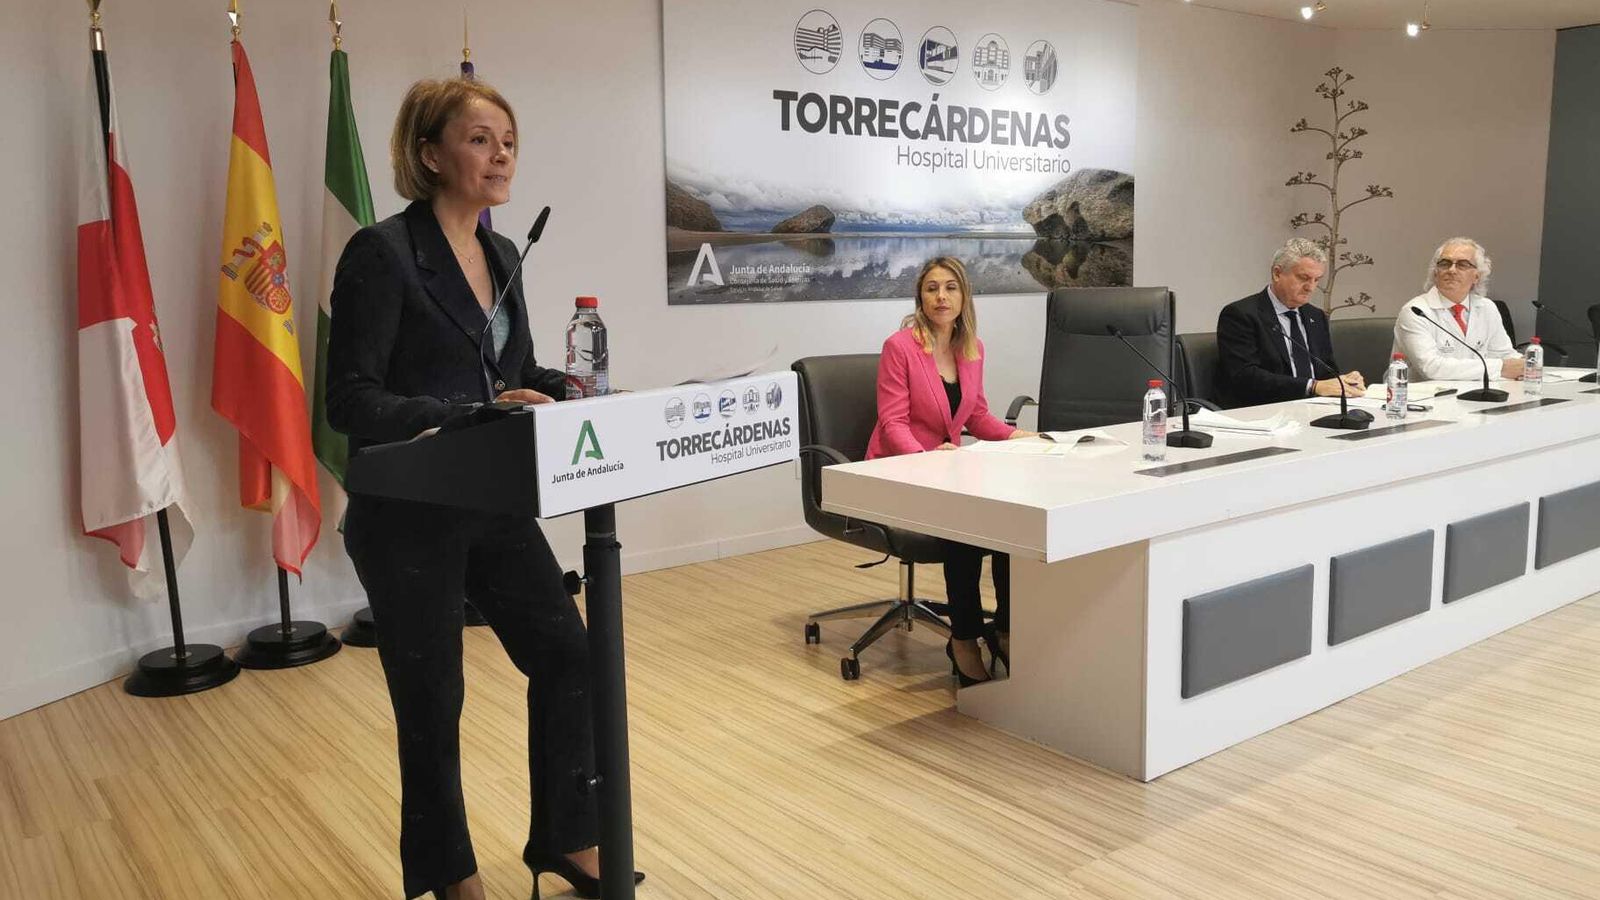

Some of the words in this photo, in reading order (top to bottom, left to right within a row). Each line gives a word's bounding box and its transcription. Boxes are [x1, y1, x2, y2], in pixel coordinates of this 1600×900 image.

[773, 90, 1071, 150] TORRECÁRDENAS
[897, 145, 968, 173] Hospital
[973, 150, 1071, 174] Universitario
[730, 265, 755, 275] Junta
[757, 264, 768, 274] de
[769, 263, 810, 274] Andalucía
[656, 417, 791, 461] TORRECÁRDENAS
[711, 447, 744, 464] Hospital
[745, 438, 791, 457] Universitario
[552, 472, 574, 484] Junta
[576, 469, 586, 478] de
[587, 460, 624, 477] Andalucía
